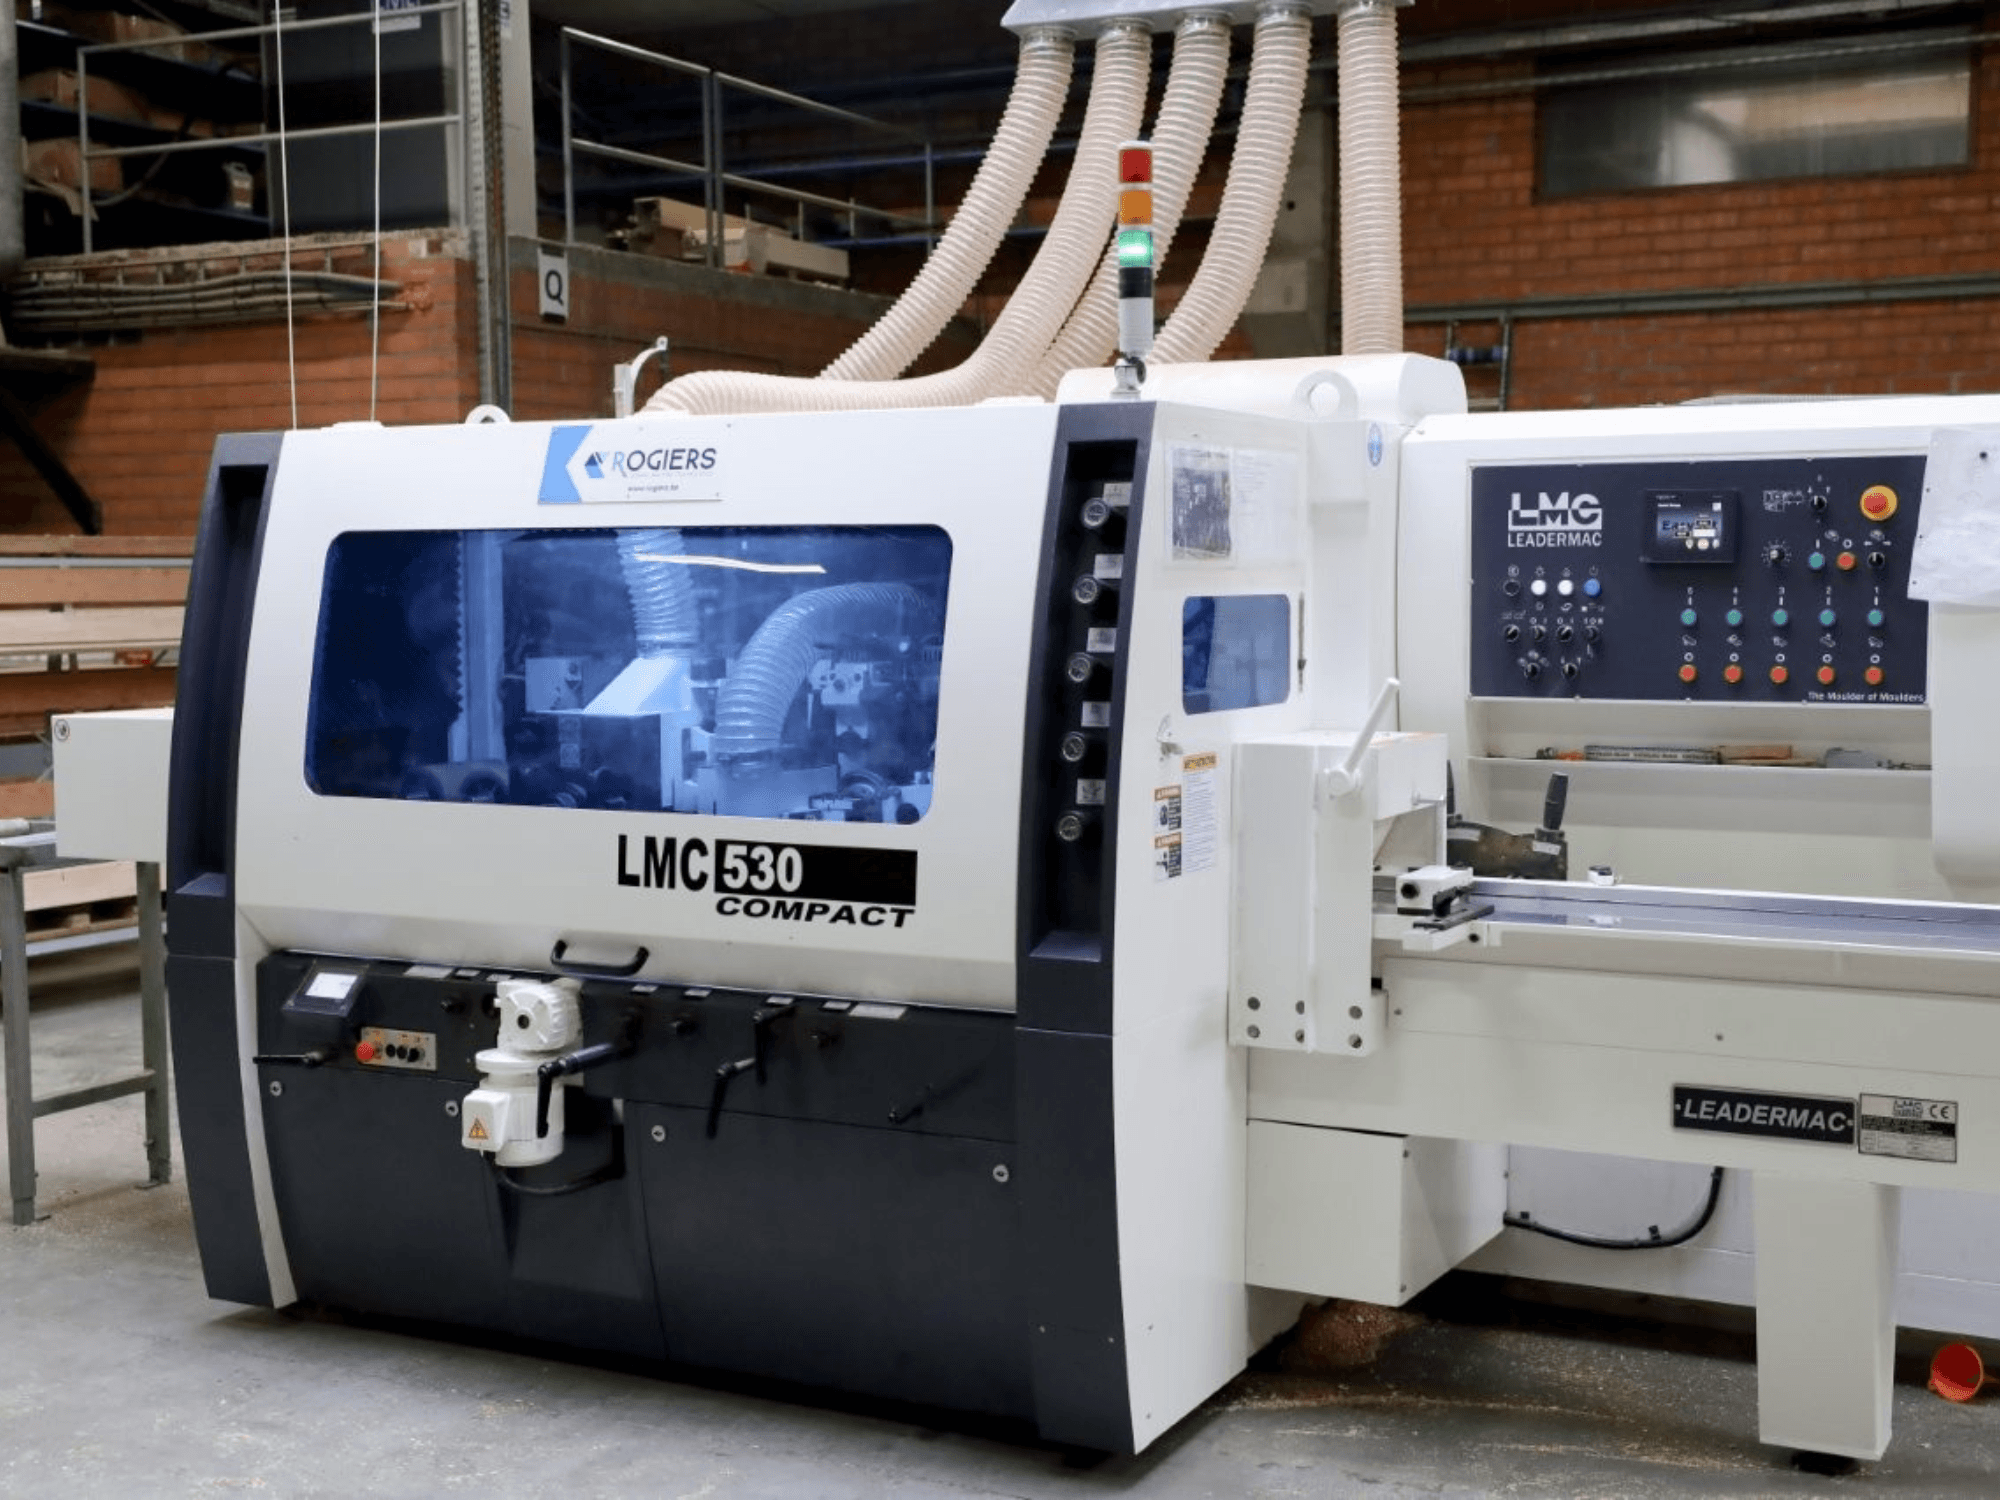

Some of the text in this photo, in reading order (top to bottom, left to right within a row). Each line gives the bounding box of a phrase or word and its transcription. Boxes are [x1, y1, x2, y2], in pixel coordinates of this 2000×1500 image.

[545, 269, 564, 306] Q
[613, 447, 716, 477] ROGIERS
[1507, 532, 1602, 548] LEADERMAC
[1807, 691, 1924, 703] The Moulder of Moulders
[618, 834, 803, 892] LMC 530
[716, 897, 915, 928] COMPACT
[1683, 1099, 1847, 1132] LEADERMAC
